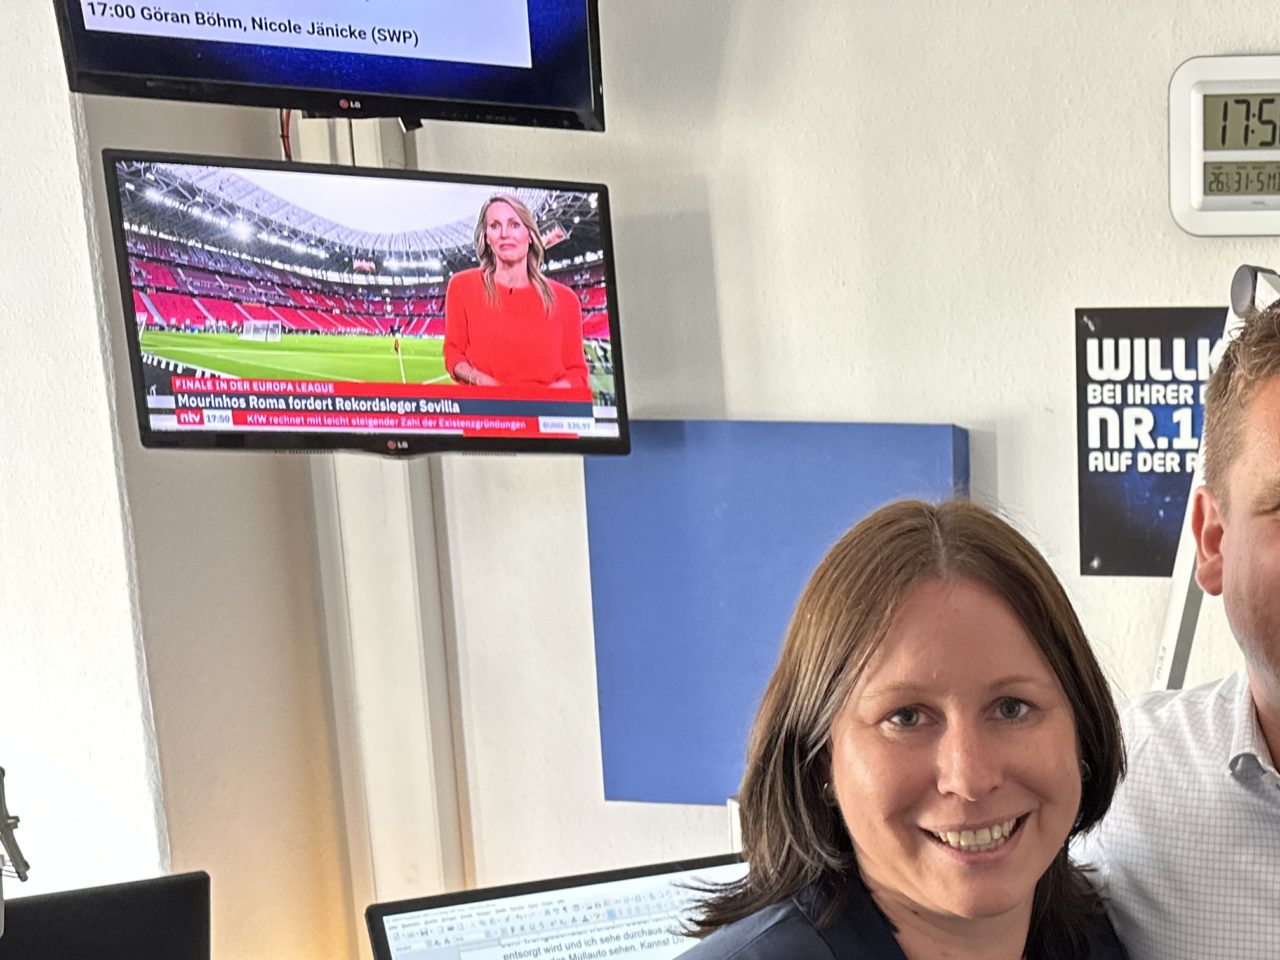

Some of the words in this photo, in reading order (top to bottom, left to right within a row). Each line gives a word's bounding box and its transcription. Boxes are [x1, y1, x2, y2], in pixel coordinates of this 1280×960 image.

[87, 2, 136, 19] 17:00
[140, 6, 191, 25] Göran
[195, 10, 248, 32] Böhm,
[251, 16, 302, 34] Nicole
[306, 21, 367, 40] Jänicke
[371, 26, 419, 48] (SWP)
[175, 380, 212, 391] FINALE
[216, 381, 225, 391] IN
[230, 381, 250, 392] DER
[253, 382, 294, 393] EUROPA
[296, 383, 334, 394] LEAGUE
[1087, 384, 1122, 405] BEI
[1127, 384, 1194, 405] IHRER
[178, 394, 246, 409] Mourinhos
[249, 396, 286, 410] Roma
[289, 396, 333, 411] fordert
[335, 398, 416, 415] Rekordsieger
[419, 399, 461, 414] Sevilla
[180, 412, 200, 423] ntv
[246, 414, 267, 424] KfW
[269, 415, 304, 426] rechnet
[307, 415, 321, 426] mit
[324, 416, 350, 427] leicht
[351, 417, 399, 429] steigender
[401, 418, 421, 428] Zahl
[422, 418, 437, 428] der
[438, 419, 527, 431] Existenzgründungen
[1087, 406, 1199, 449] NR.1
[1089, 452, 1133, 472] AUF
[1137, 452, 1181, 473] DER
[503, 947, 542, 960] entsorgt
[544, 941, 563, 954] wird
[565, 938, 583, 950] und
[584, 934, 598, 947] ich
[599, 930, 622, 944] sehe
[639, 936, 670, 951] Kannst
